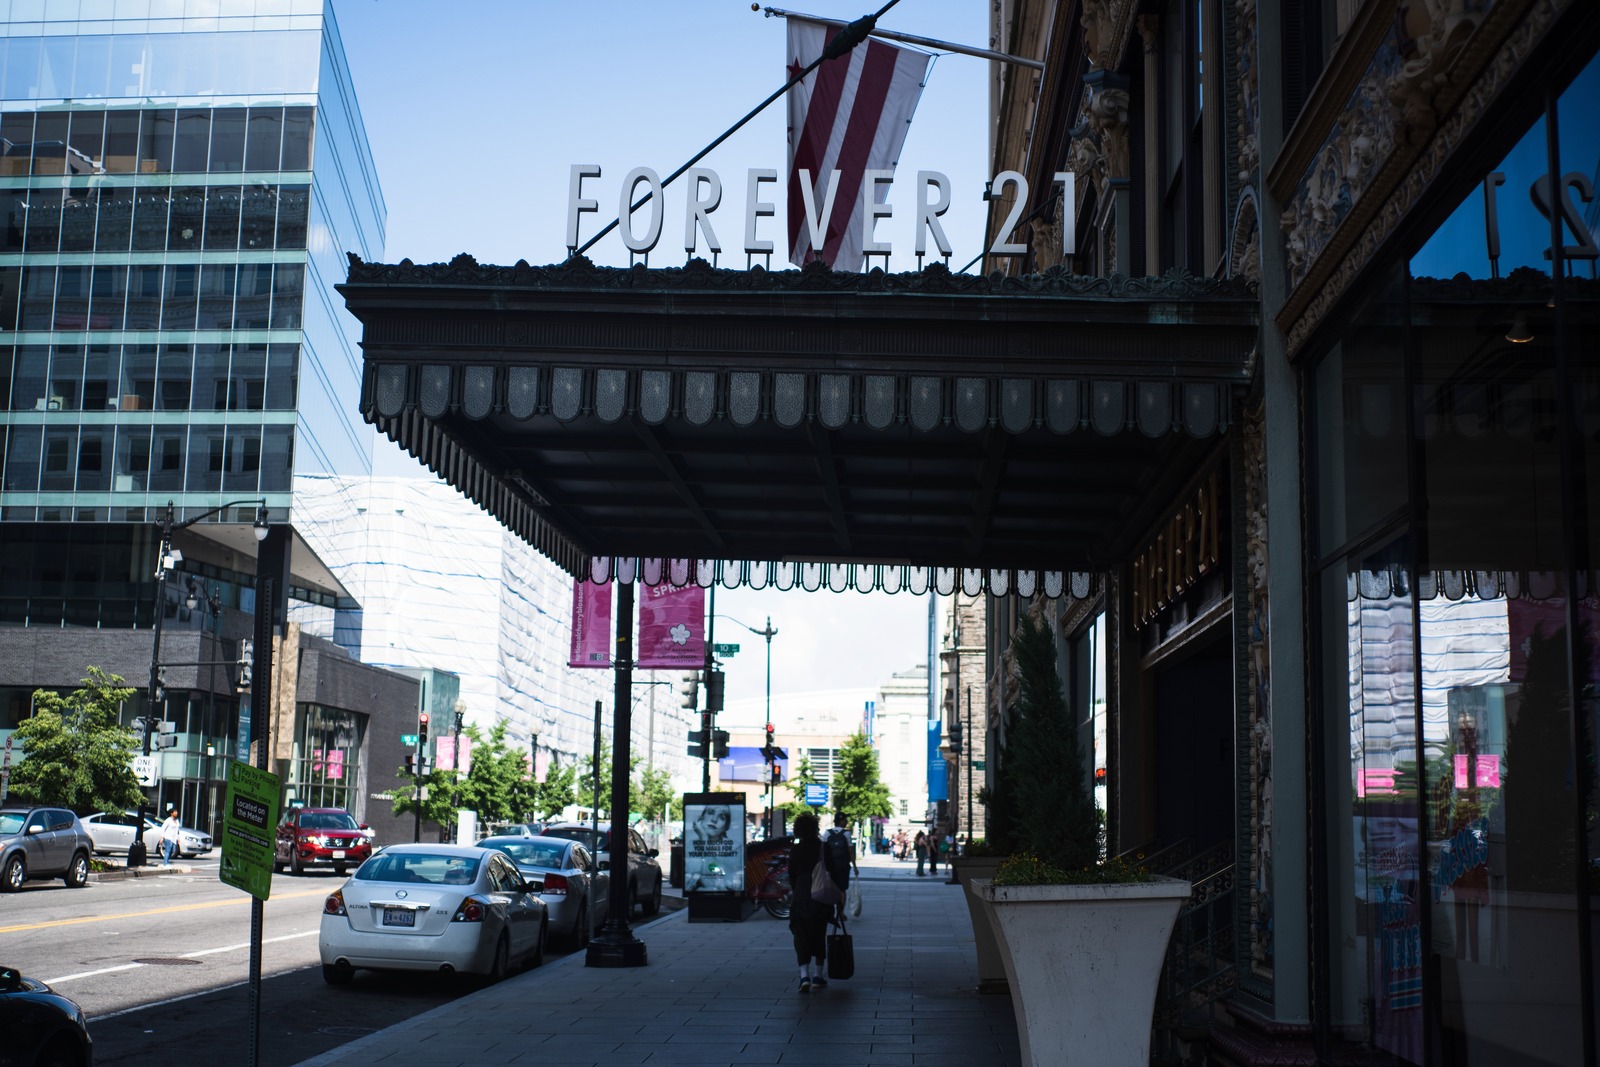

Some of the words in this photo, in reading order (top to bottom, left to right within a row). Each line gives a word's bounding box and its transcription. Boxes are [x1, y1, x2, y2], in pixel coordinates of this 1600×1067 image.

[566, 164, 952, 257] FOREVER
[990, 171, 1076, 258] 21
[653, 580, 698, 597] SPR
[719, 644, 729, 652] 10
[137, 758, 152, 766] ONE
[135, 766, 151, 774] WAY
[241, 768, 251, 779] Pay
[252, 771, 258, 781] by
[259, 774, 275, 785] Phone
[241, 776, 261, 790] Parking
[236, 798, 257, 813] Located
[237, 808, 246, 818] the
[247, 811, 263, 823] Meter
